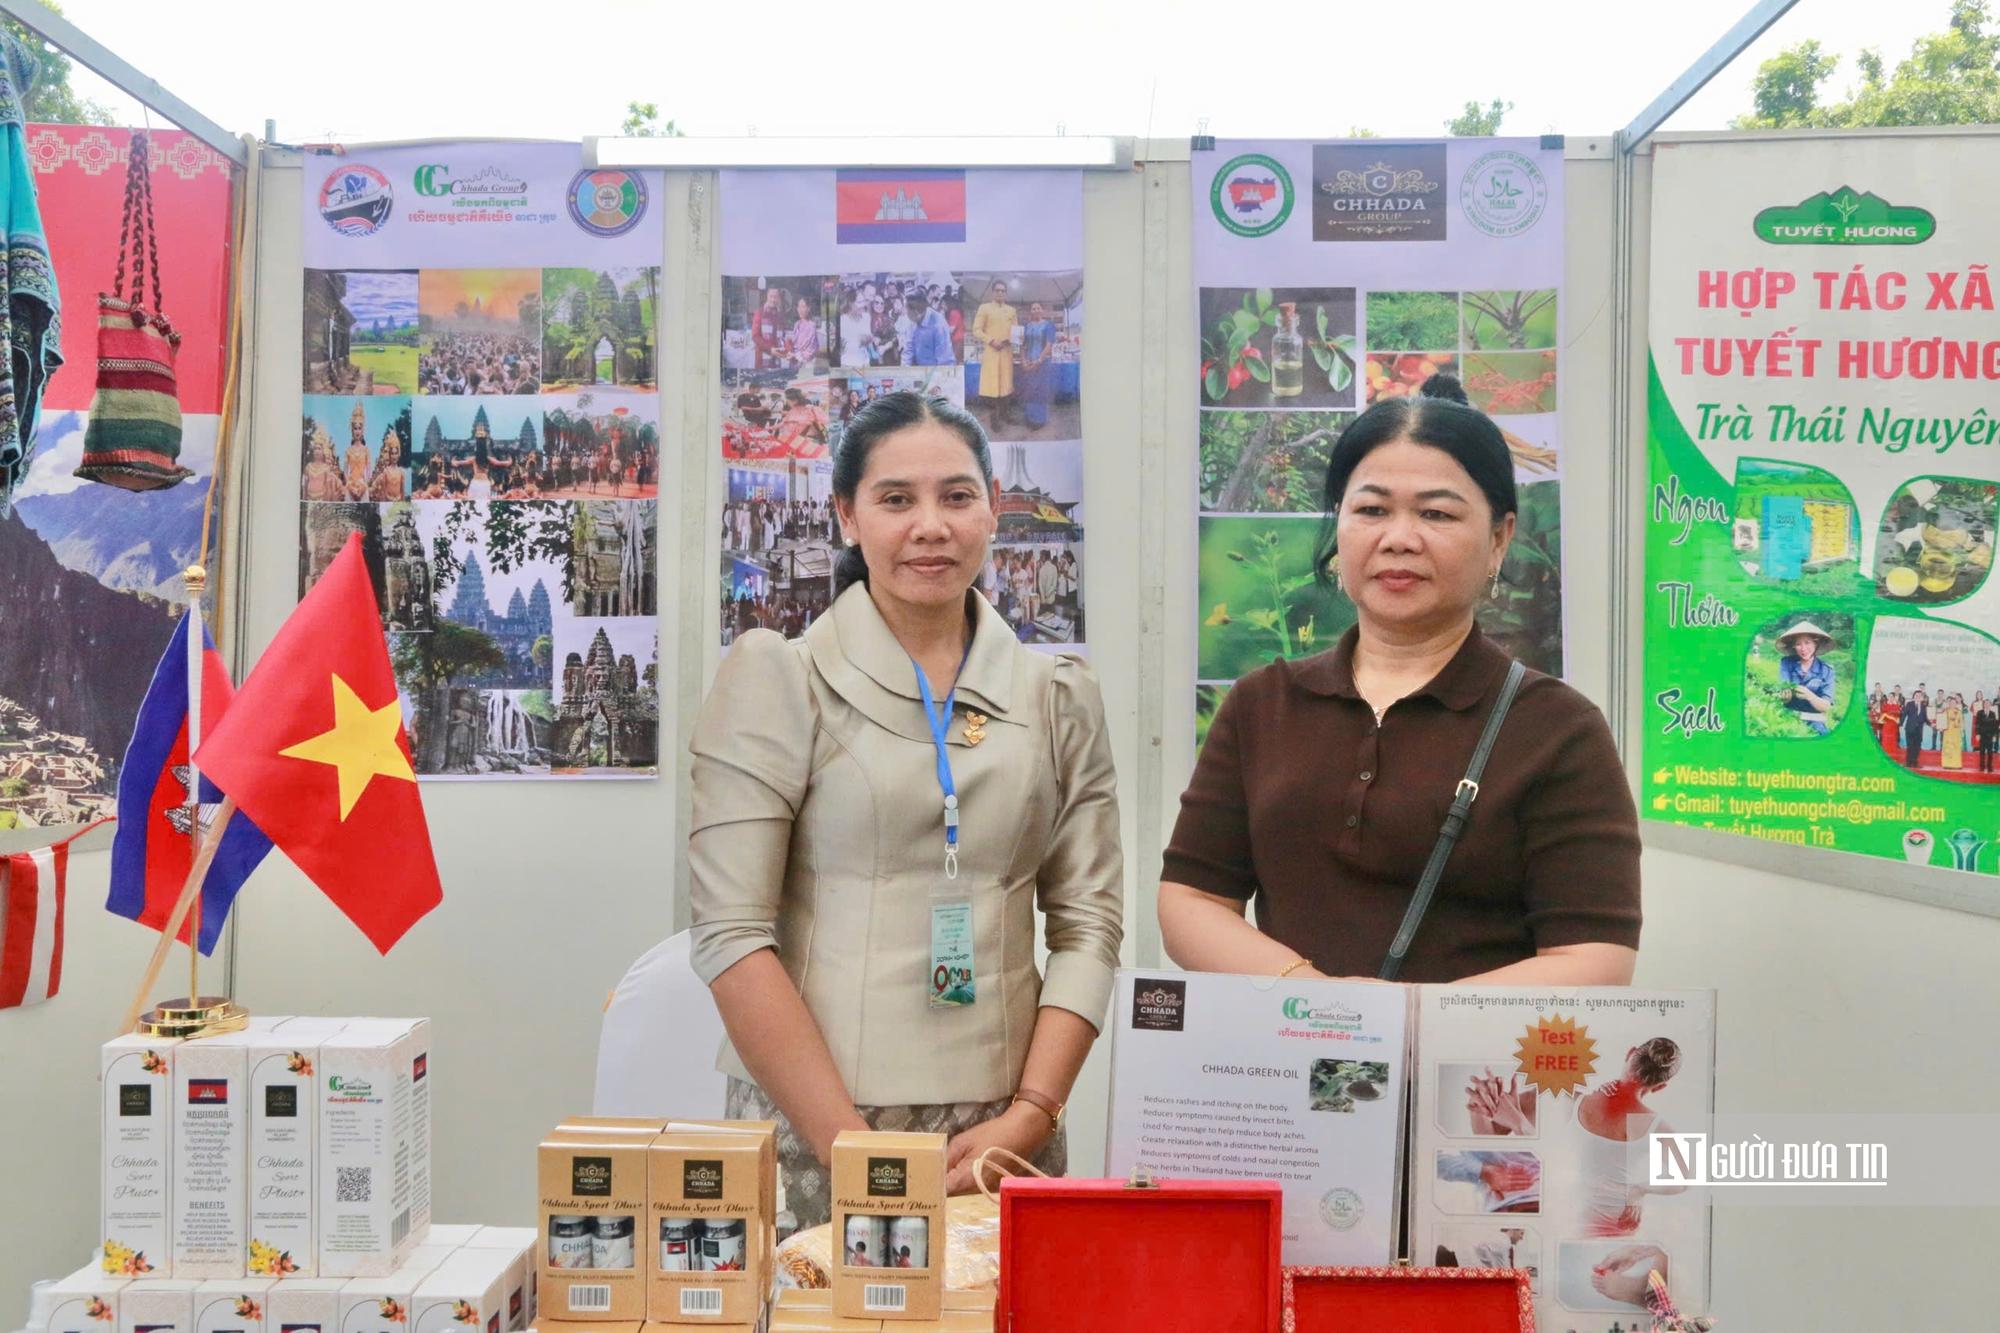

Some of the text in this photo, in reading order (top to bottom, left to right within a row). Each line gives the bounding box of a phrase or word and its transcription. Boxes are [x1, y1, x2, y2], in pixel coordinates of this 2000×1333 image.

[1372, 175, 1387, 189] C
[1333, 198, 1426, 211] CHHADA
[1357, 212, 1402, 221] GROUP
[1772, 222, 1917, 237] TUYẾT HƯƠNG
[1698, 264, 1995, 317] HỢP TÁC XÃ
[1674, 326, 1822, 377] TUYẾT
[1696, 403, 1754, 441] Trà
[1767, 404, 1847, 443] Thái
[1655, 475, 1729, 544] Ngon
[1657, 687, 1724, 738] Sạch
[1675, 765, 1895, 794] Website: tuyethuongtra.com
[1674, 793, 1945, 825] Gmail: tuyethuongche@gmail.com
[1810, 826, 1835, 845] Trà
[1140, 1006, 1177, 1015] CHHADA
[1538, 1028, 1575, 1045] Test
[1535, 1055, 1578, 1071] FREE
[1202, 1064, 1299, 1079] CHHADA GREEN OIL
[1144, 1096, 1174, 1104] Reduces
[1176, 1098, 1199, 1106] rashes
[1217, 1101, 1242, 1110] itching
[1269, 1104, 1288, 1112] body
[1143, 1109, 1295, 1126] Reduces symptoms caused by insect bites
[1143, 1122, 1161, 1130] Used
[1162, 1123, 1173, 1131] for
[1175, 1126, 1207, 1134] massage
[1218, 1128, 1235, 1136] help
[1236, 1129, 1261, 1137] reduce
[1263, 1131, 1281, 1139] body
[1141, 1135, 1166, 1143] Create
[1168, 1137, 1204, 1146] relaxation
[1206, 1140, 1221, 1148] with
[1230, 1142, 1268, 1150] distinctive
[1269, 1144, 1293, 1152] herbal
[111, 1155, 160, 1169] Chhada
[257, 1155, 304, 1169] Chhada
[1141, 1149, 1172, 1158] Reduces
[1173, 1152, 1211, 1161] symptoms
[1279, 1160, 1320, 1168] congestion
[1160, 1164, 1181, 1172] herbs
[1192, 1165, 1223, 1174] Thailand
[189, 1201, 225, 1209] BENEFITS
[542, 1199, 579, 1208] Chhada
[582, 1200, 609, 1209] Sport
[653, 1202, 690, 1211] Chhada
[693, 1203, 720, 1212] Sport
[837, 1198, 875, 1209] Chhada
[877, 1200, 905, 1210] Sport
